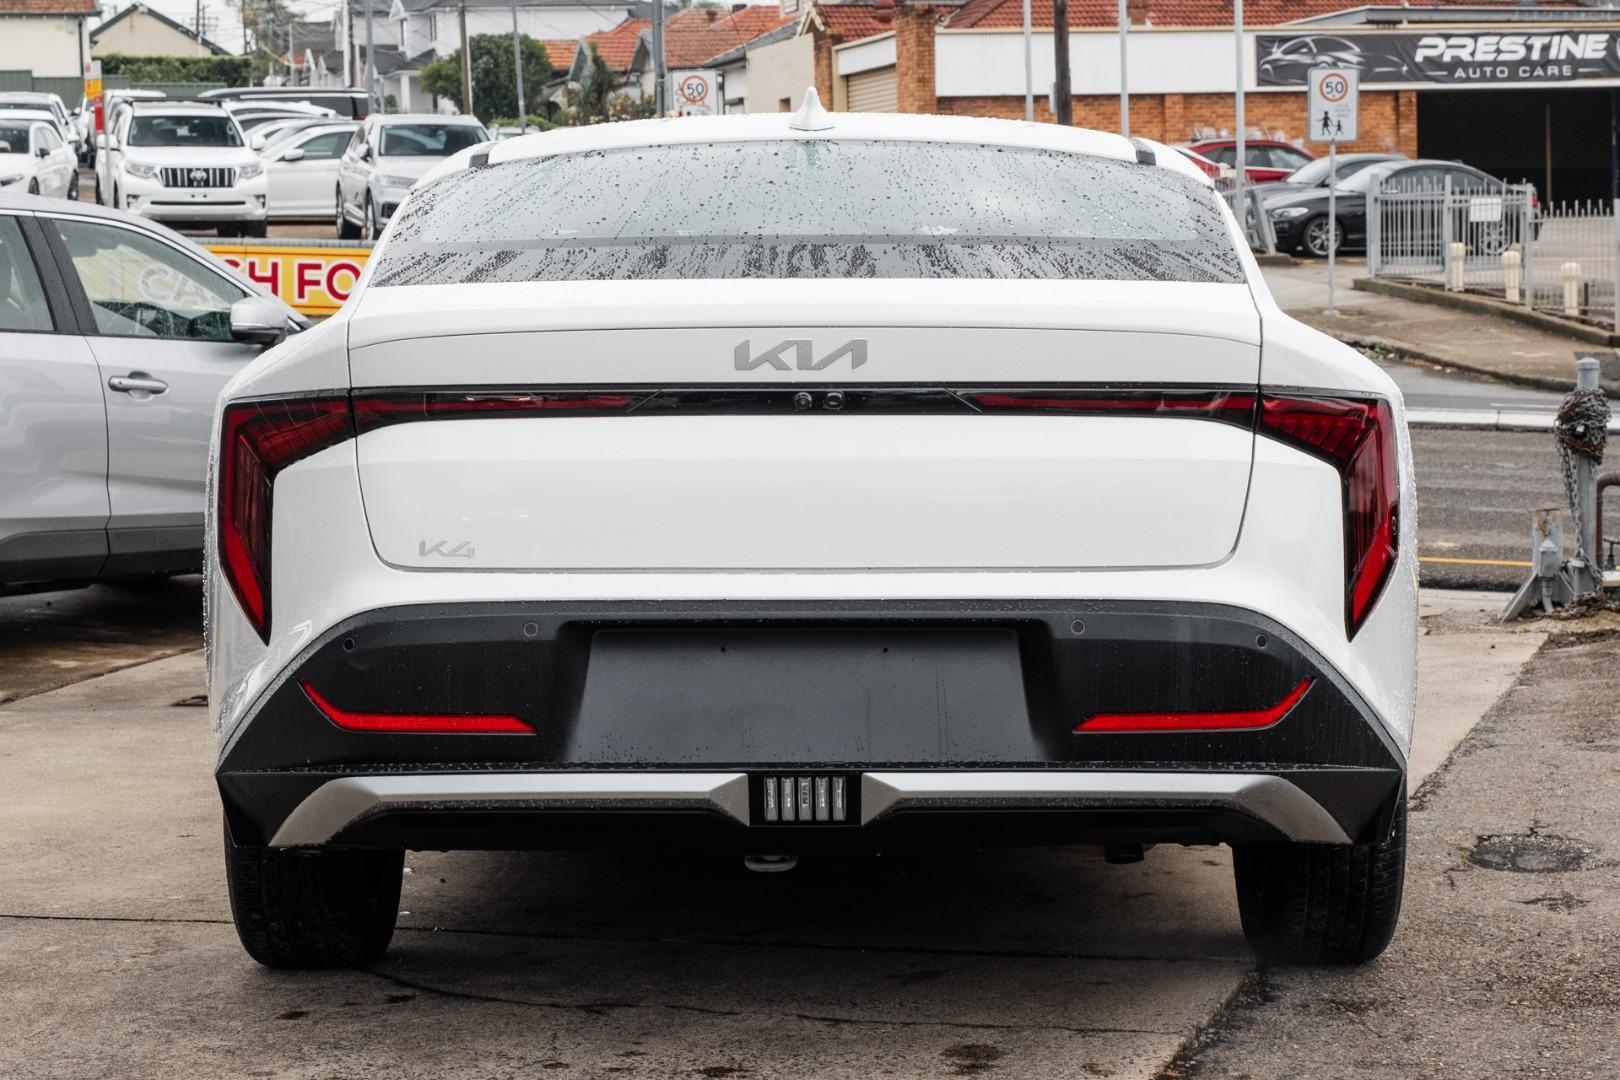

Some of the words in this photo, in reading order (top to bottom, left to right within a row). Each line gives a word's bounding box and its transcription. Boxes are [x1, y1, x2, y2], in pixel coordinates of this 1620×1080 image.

[1414, 34, 1610, 62] PRESTINE
[1454, 66, 1509, 78] AUTO
[1518, 65, 1573, 77] CARE
[687, 83, 704, 97] 50
[1325, 81, 1344, 94] 50
[734, 339, 868, 371] KIA
[419, 540, 476, 559] K4
